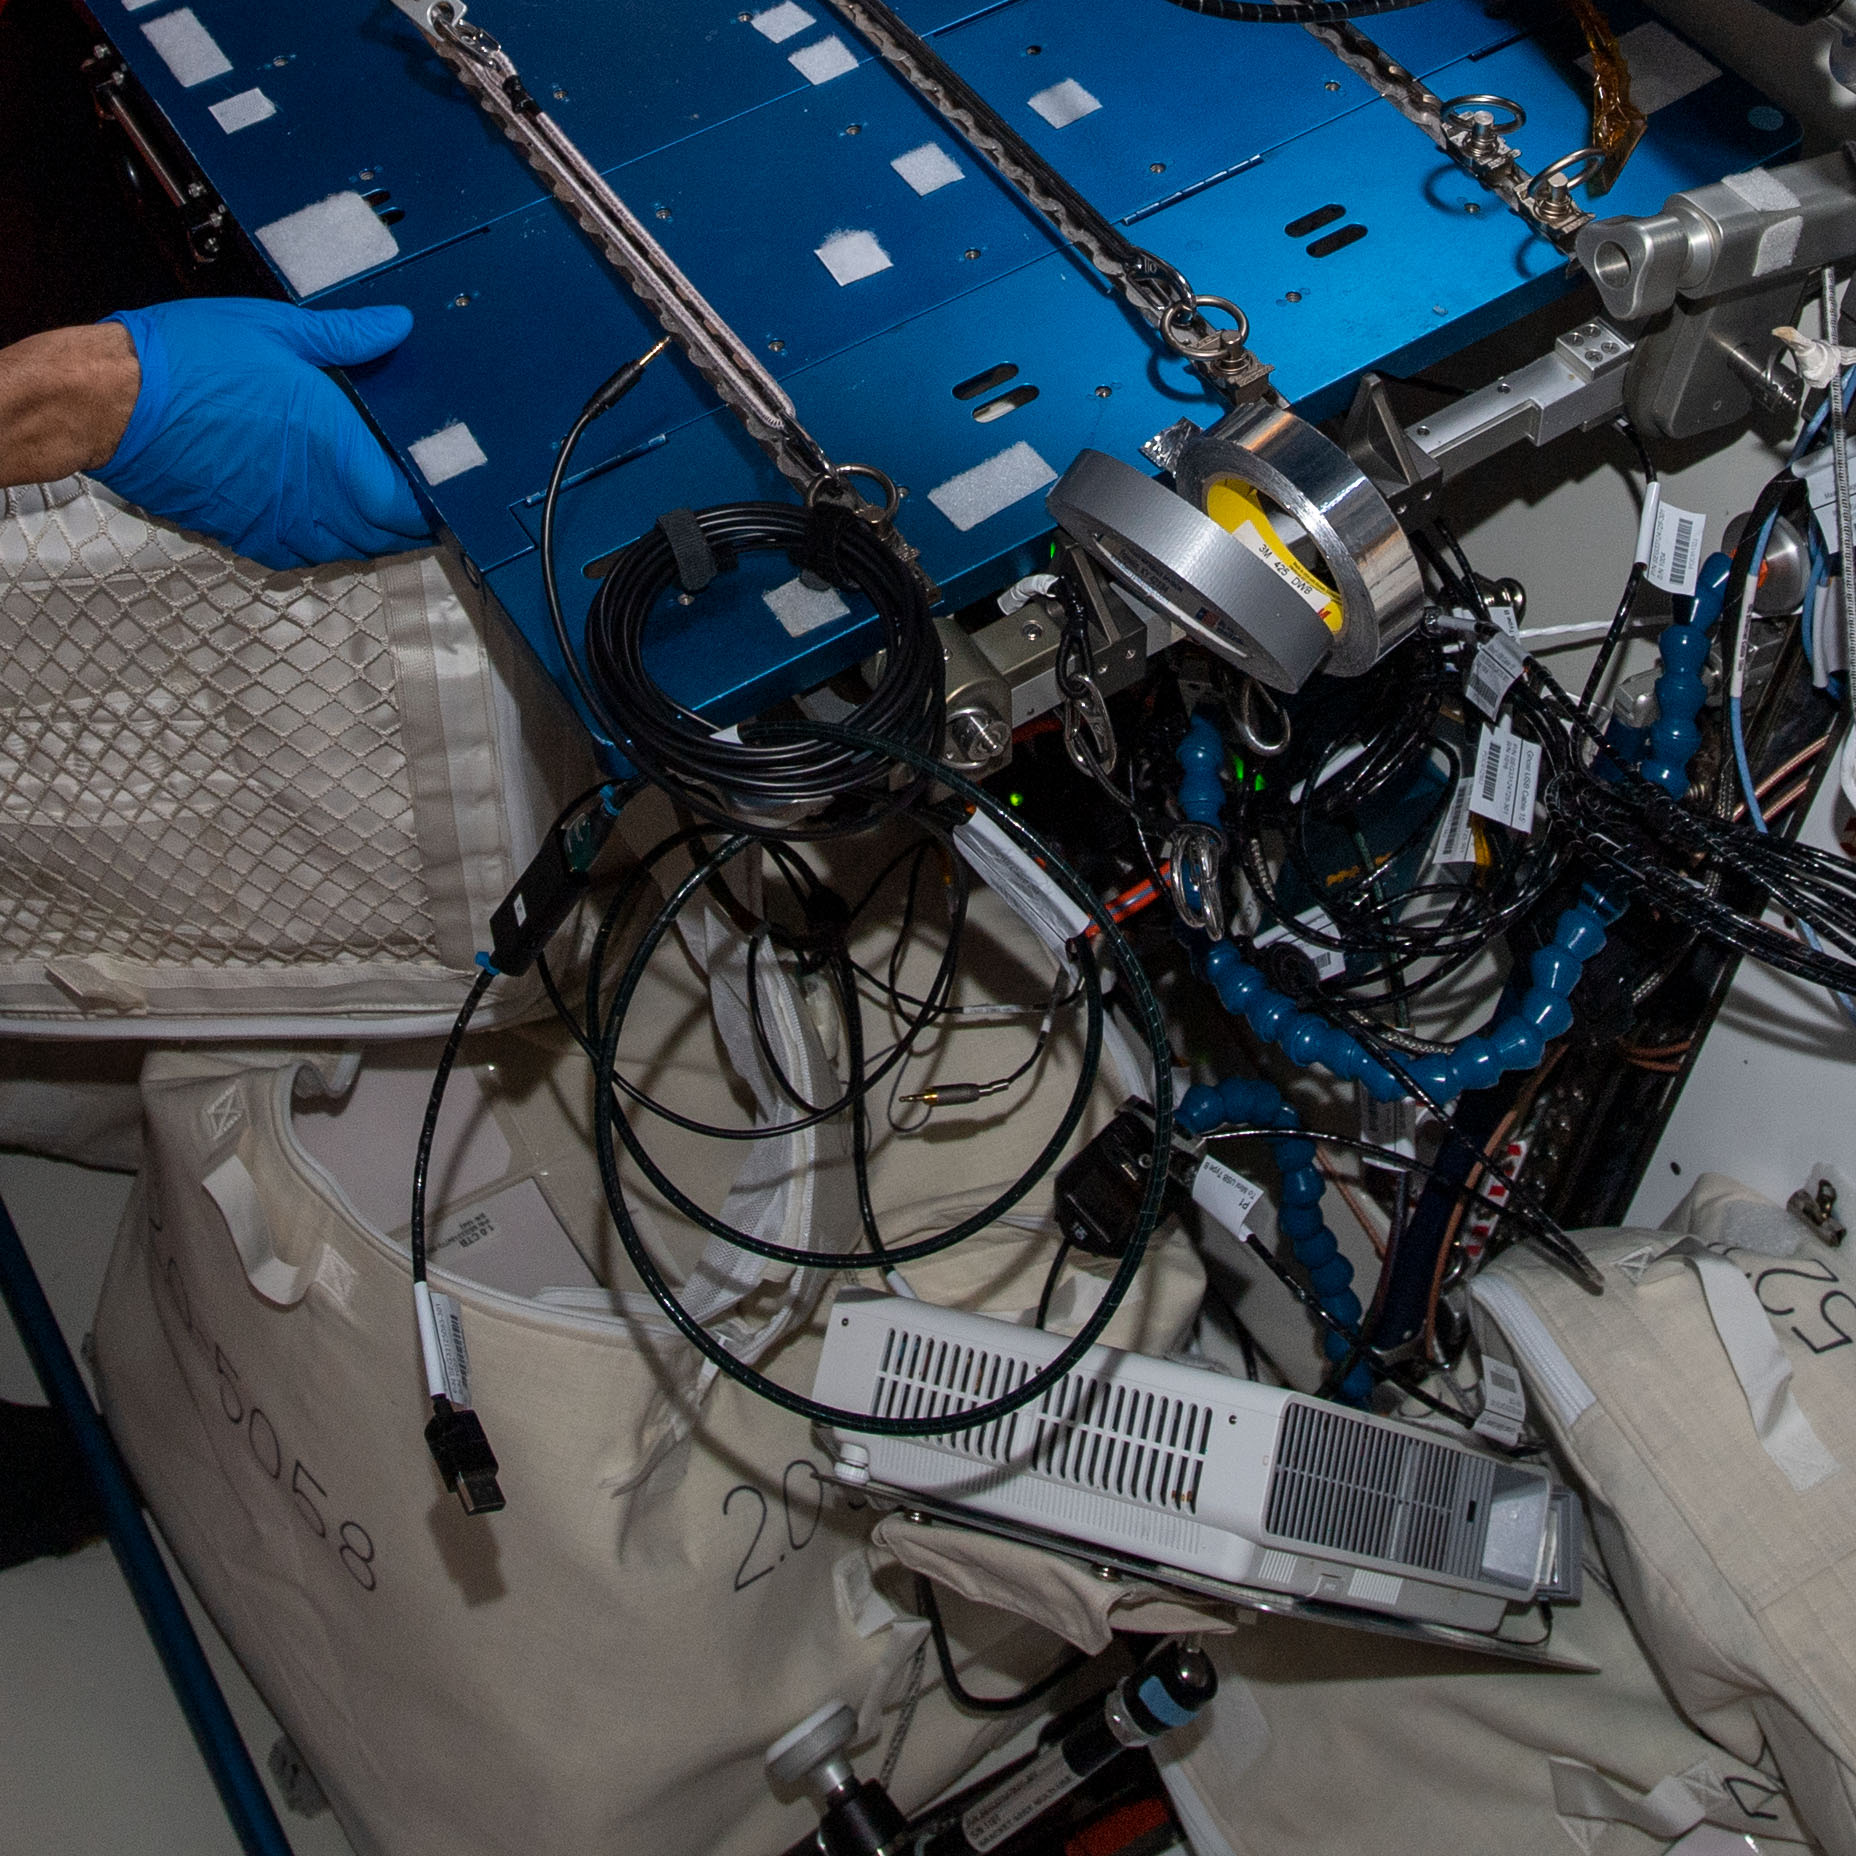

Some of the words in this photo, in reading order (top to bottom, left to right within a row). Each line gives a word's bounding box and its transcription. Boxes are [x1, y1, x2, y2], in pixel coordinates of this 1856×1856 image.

[1258, 543, 1273, 559] 3M
[1273, 560, 1289, 577] 425
[1523, 749, 1535, 773] Ghost
[1521, 774, 1532, 789] USB
[1517, 789, 1530, 812] Cable
[1209, 1164, 1223, 1178] Type
[1222, 1174, 1236, 1186] USB
[1236, 1182, 1248, 1194] Mini
[1248, 1191, 1256, 1199] To
[1239, 1198, 1251, 1210] P1
